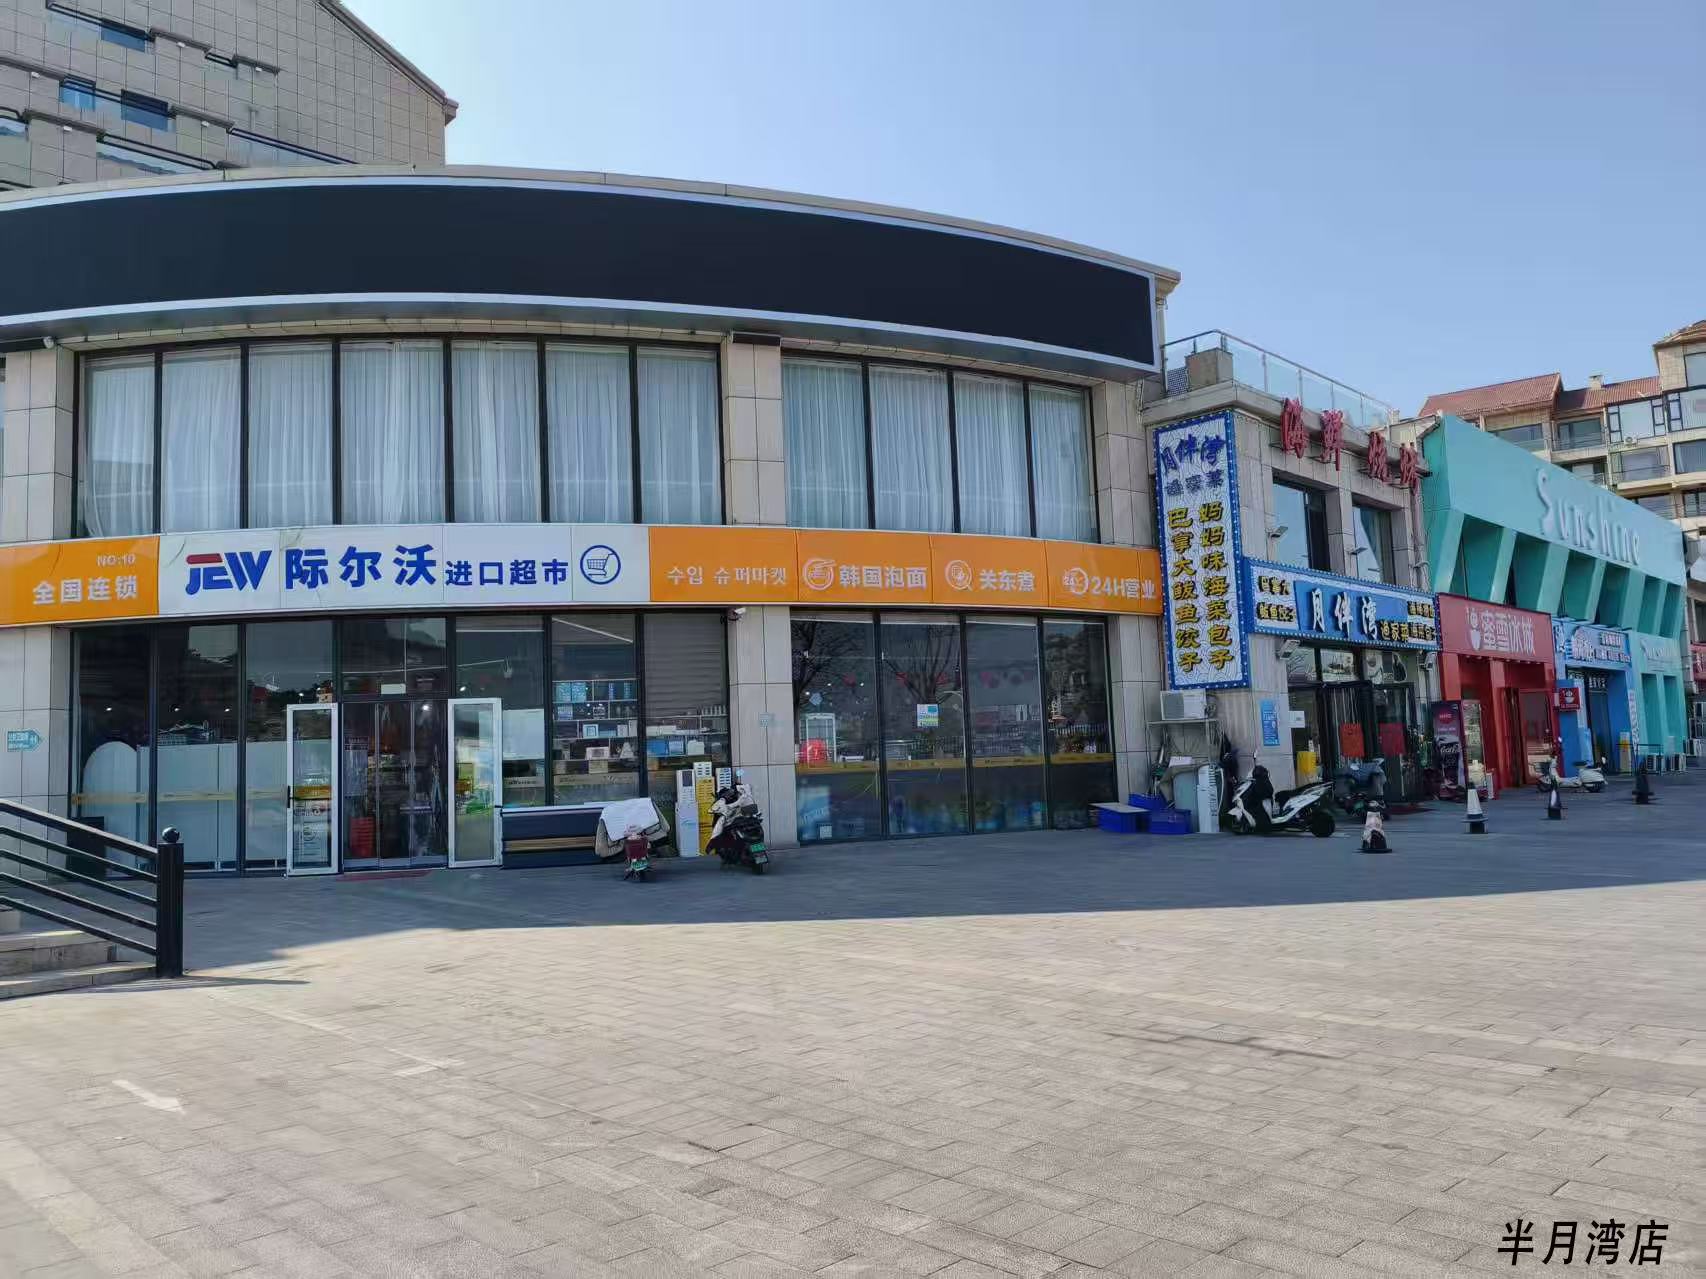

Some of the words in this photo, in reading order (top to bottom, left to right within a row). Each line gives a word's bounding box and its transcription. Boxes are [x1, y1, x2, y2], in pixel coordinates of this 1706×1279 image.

[1537, 468, 1640, 567] Sunshine
[186, 550, 273, 595] JEW
[286, 544, 437, 591] 际尔沃
[445, 558, 569, 588] 进口超市
[667, 566, 704, 585] 수입
[839, 565, 927, 589] 韩国泡面
[980, 569, 1036, 592] 关东煮
[32, 575, 137, 605] 全国连锁
[1090, 576, 1156, 600] 24H营业
[1199, 500, 1234, 671] 妈妈味海菜包子
